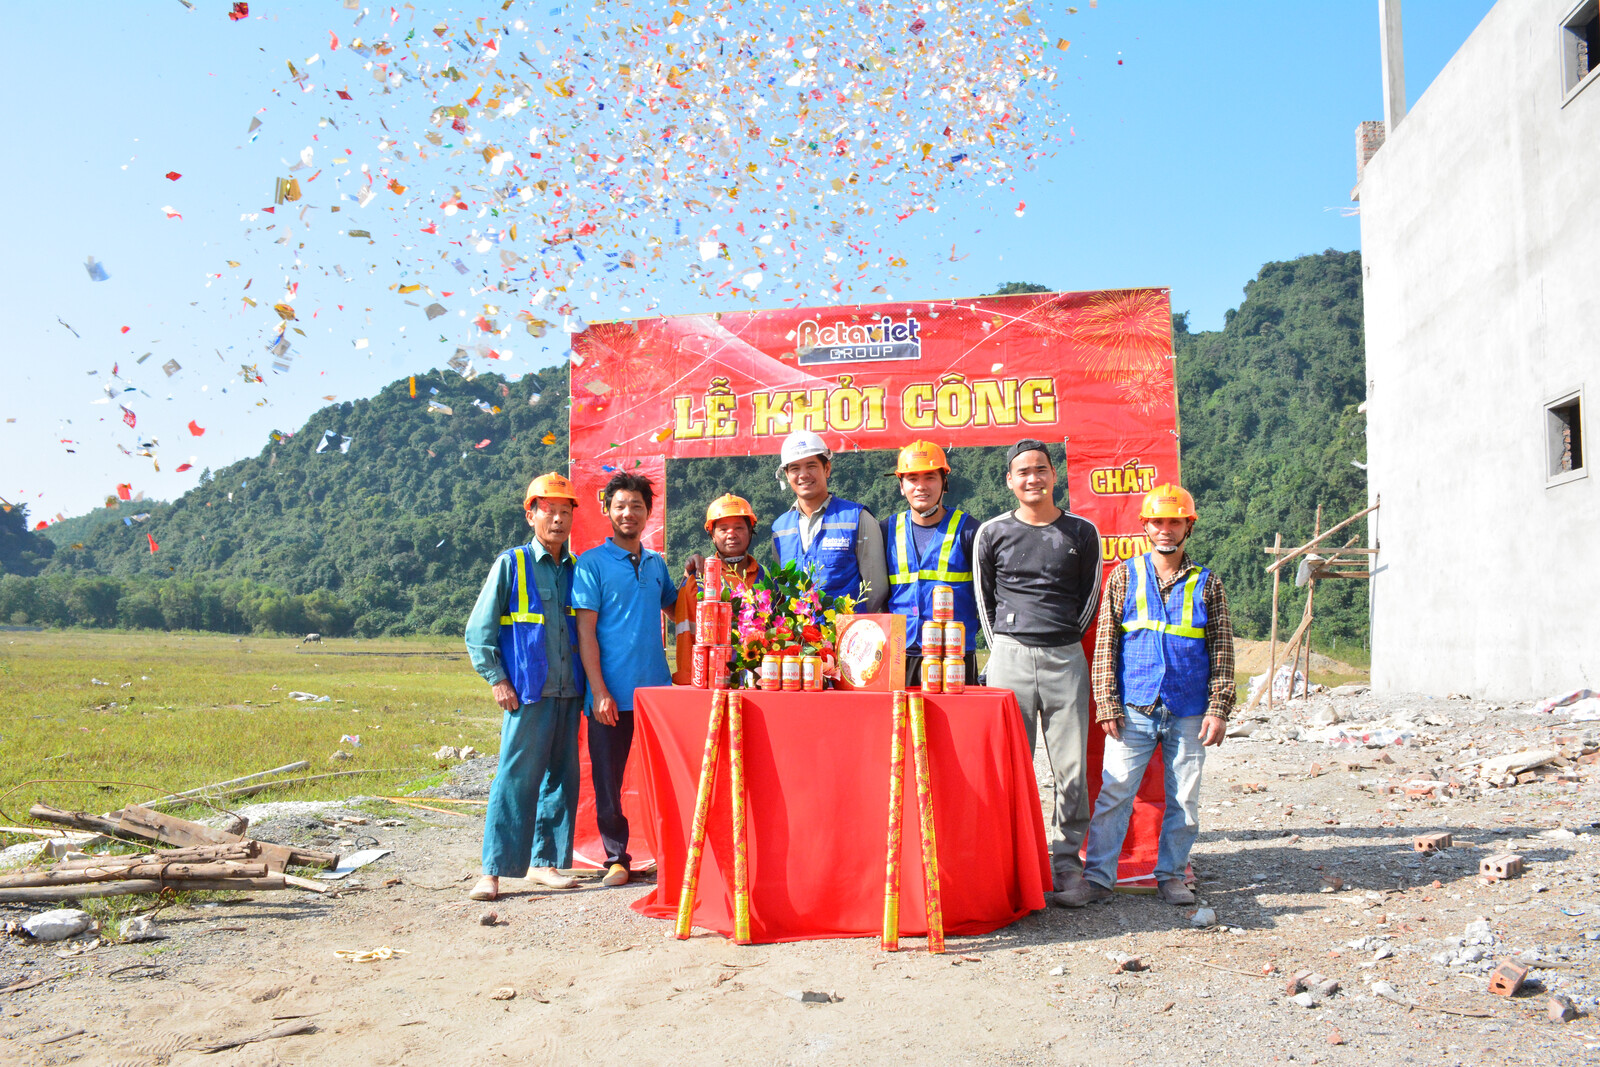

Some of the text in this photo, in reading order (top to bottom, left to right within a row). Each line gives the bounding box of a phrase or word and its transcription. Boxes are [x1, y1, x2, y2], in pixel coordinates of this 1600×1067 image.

[830, 346, 893, 359] GROUP
[673, 373, 1057, 440] LỄ KHỞI CÔNG
[1090, 458, 1156, 495] CHẤT
